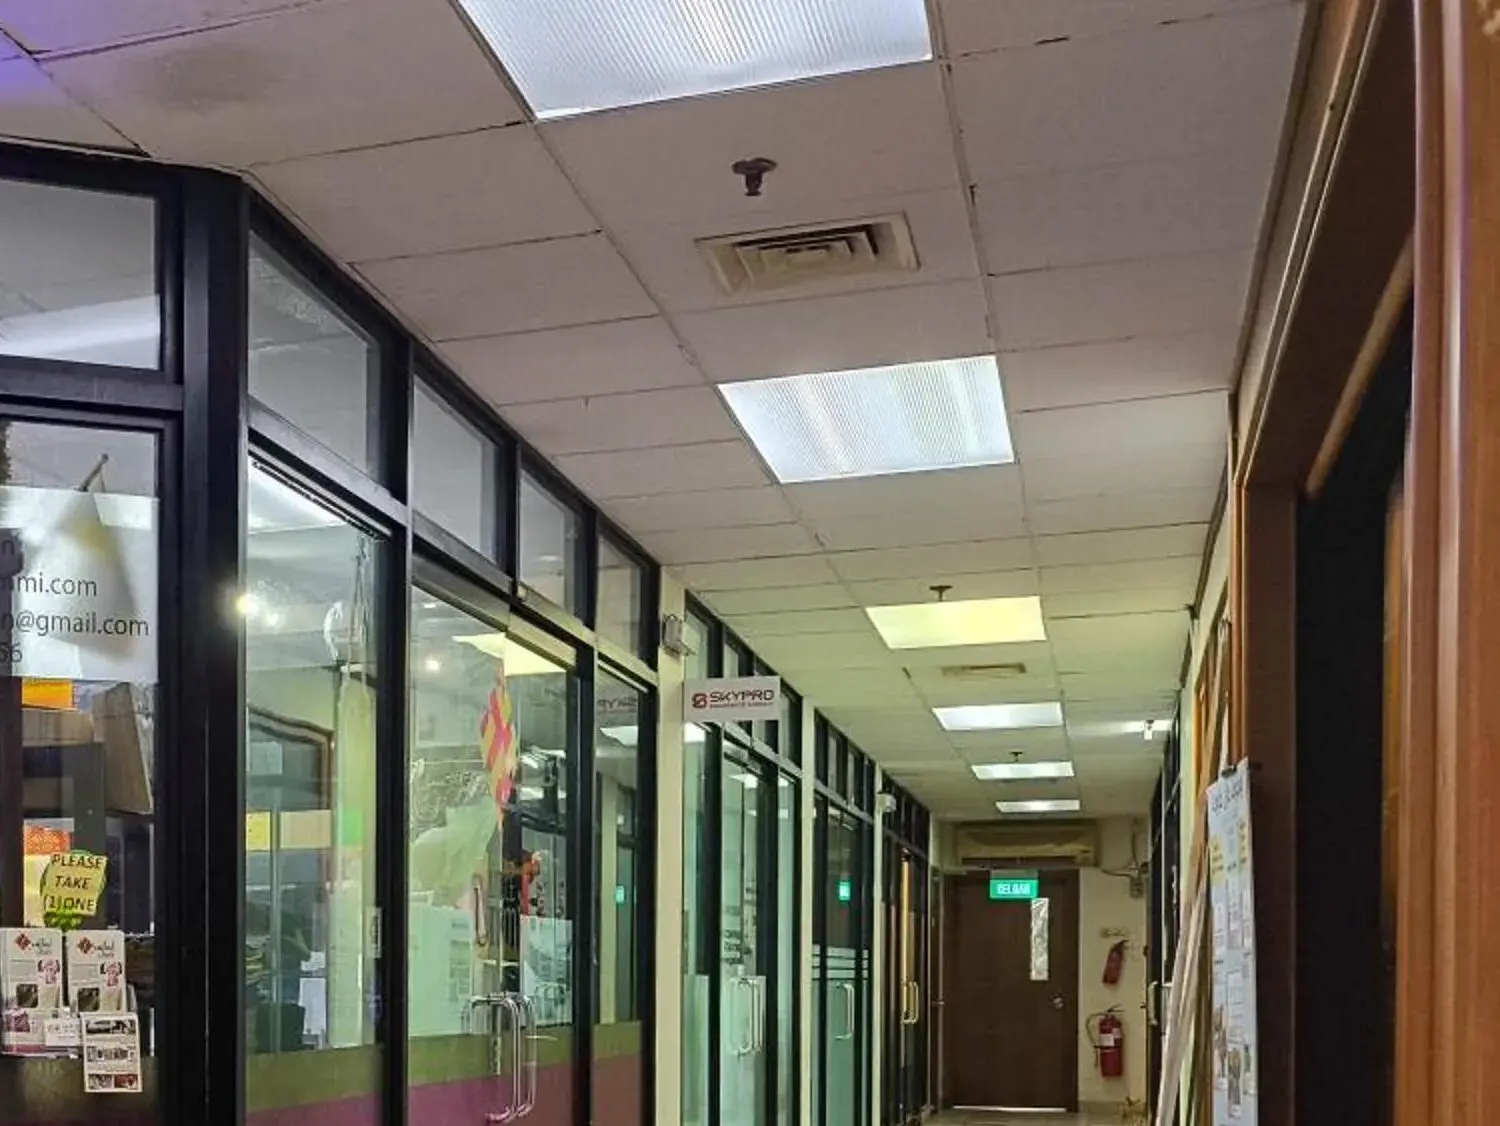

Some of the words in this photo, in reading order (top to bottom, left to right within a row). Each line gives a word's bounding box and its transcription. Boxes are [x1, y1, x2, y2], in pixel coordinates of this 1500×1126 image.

[709, 689, 775, 701] SKYPRO
[51, 853, 104, 869] PLEASE
[55, 875, 92, 890] TAKE
